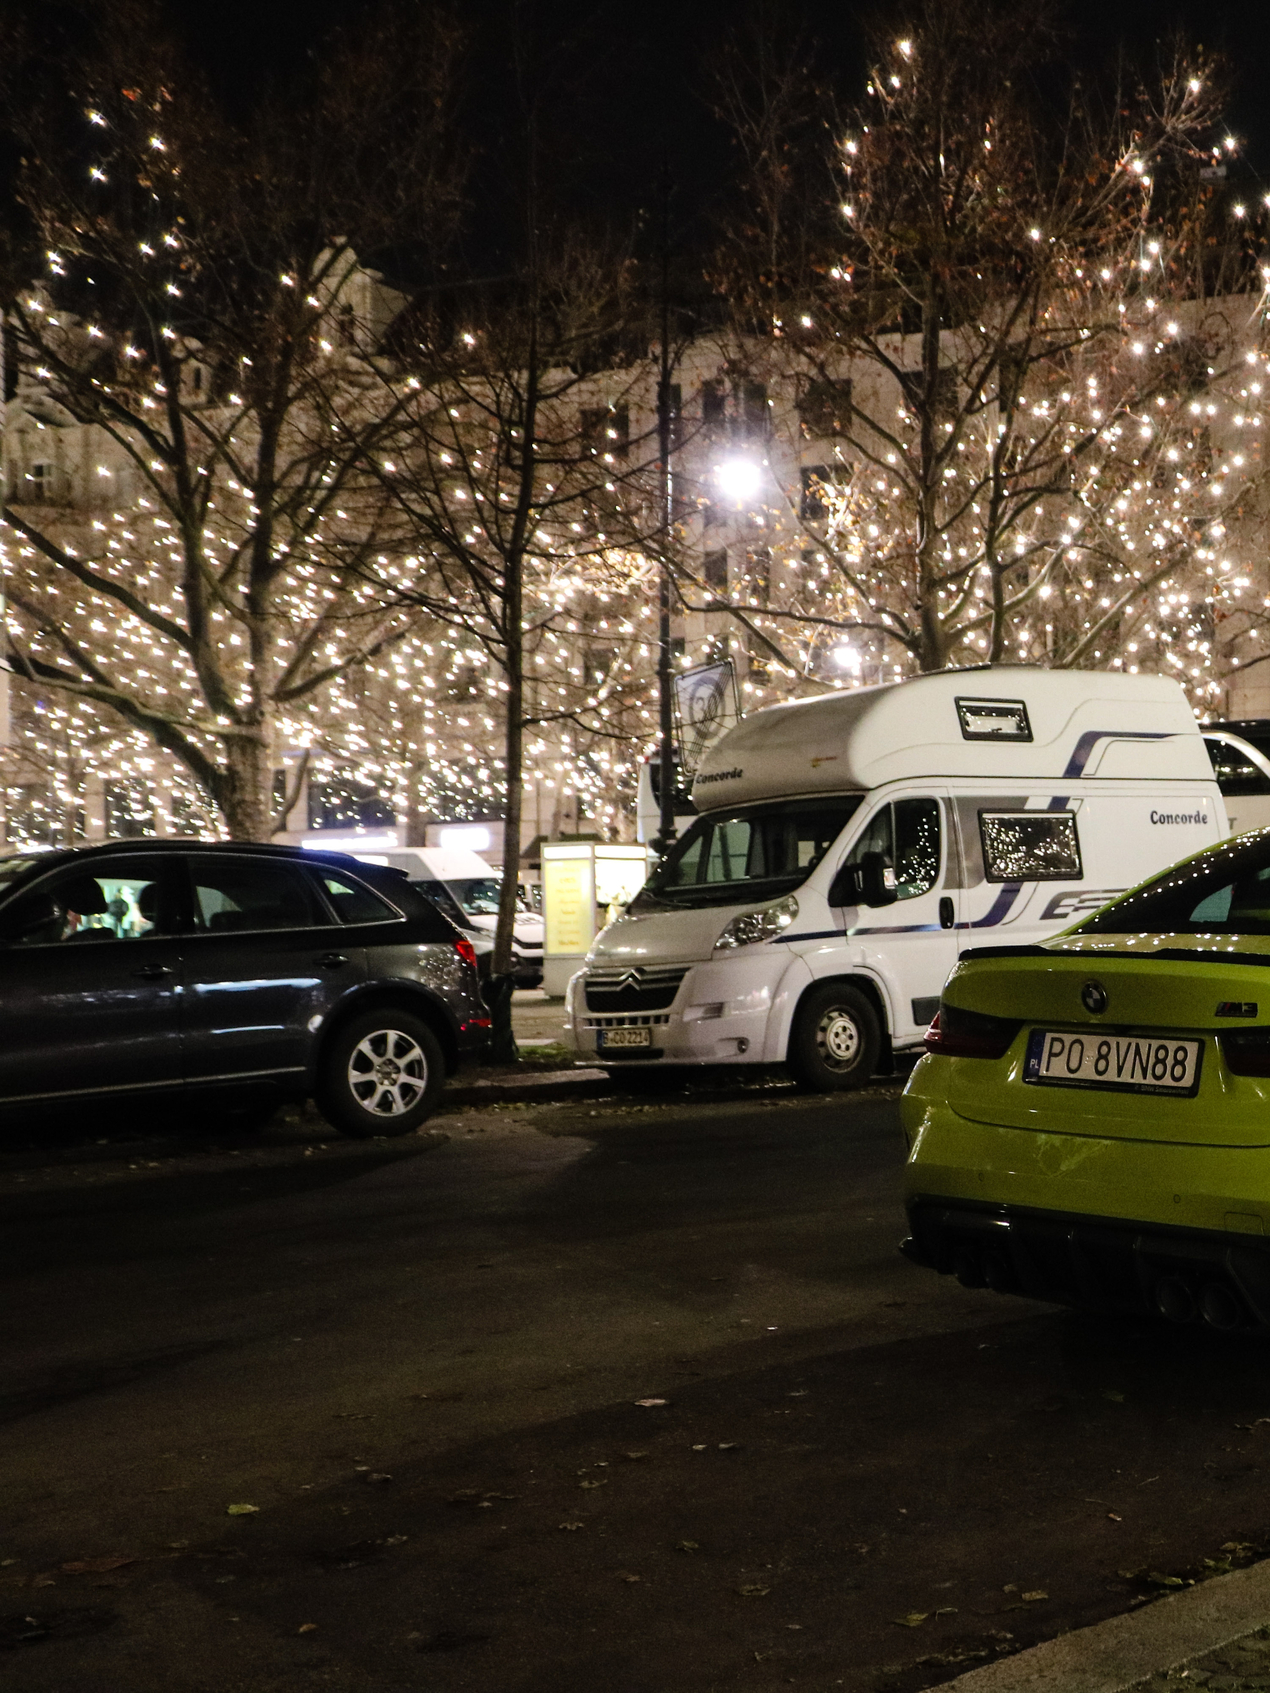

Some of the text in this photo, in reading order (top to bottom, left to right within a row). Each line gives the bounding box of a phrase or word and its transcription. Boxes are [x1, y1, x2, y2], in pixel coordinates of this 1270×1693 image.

[696, 768, 743, 784] Concorde
[1150, 810, 1208, 825] Concorde
[1030, 1058, 1039, 1069] PL
[1094, 1040, 1188, 1082] 8VN88
